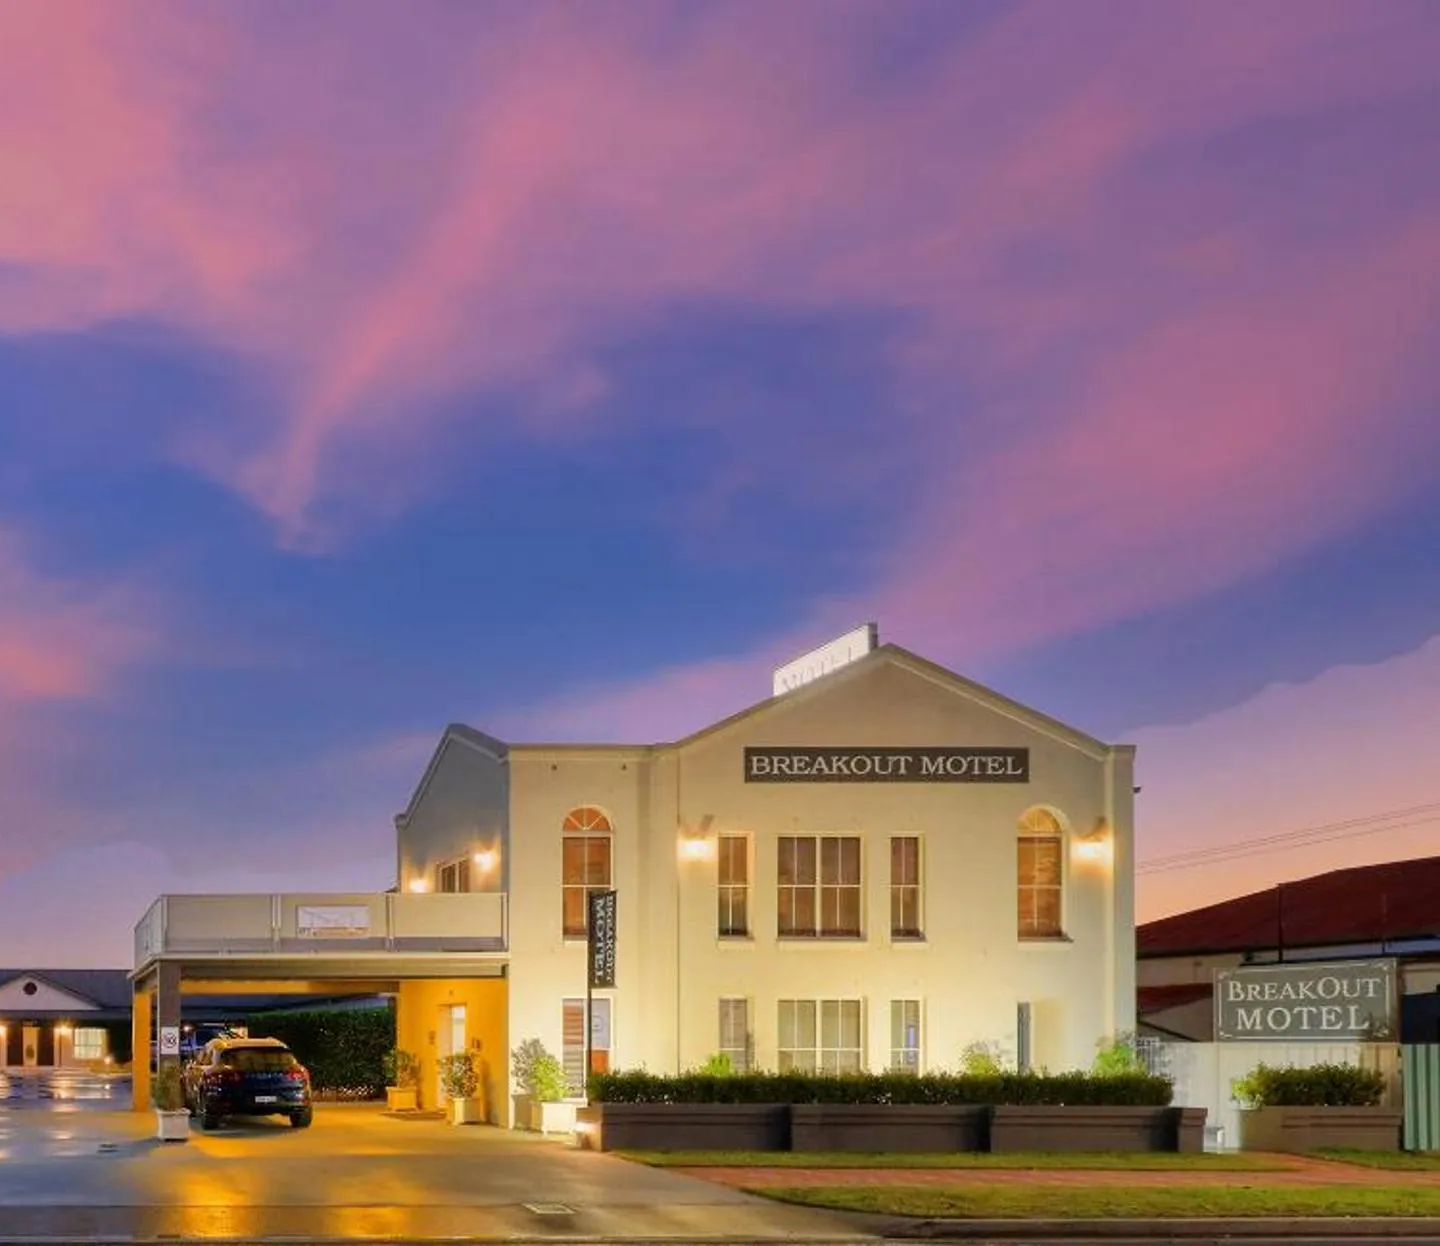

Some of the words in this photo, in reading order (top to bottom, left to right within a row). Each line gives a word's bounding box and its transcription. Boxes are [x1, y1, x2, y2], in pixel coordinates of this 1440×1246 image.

[750, 755, 913, 775] BREAKOUT
[921, 755, 1023, 775] MOTEL
[594, 896, 605, 984] MOTEL
[1236, 1004, 1370, 1031] MOTEL
